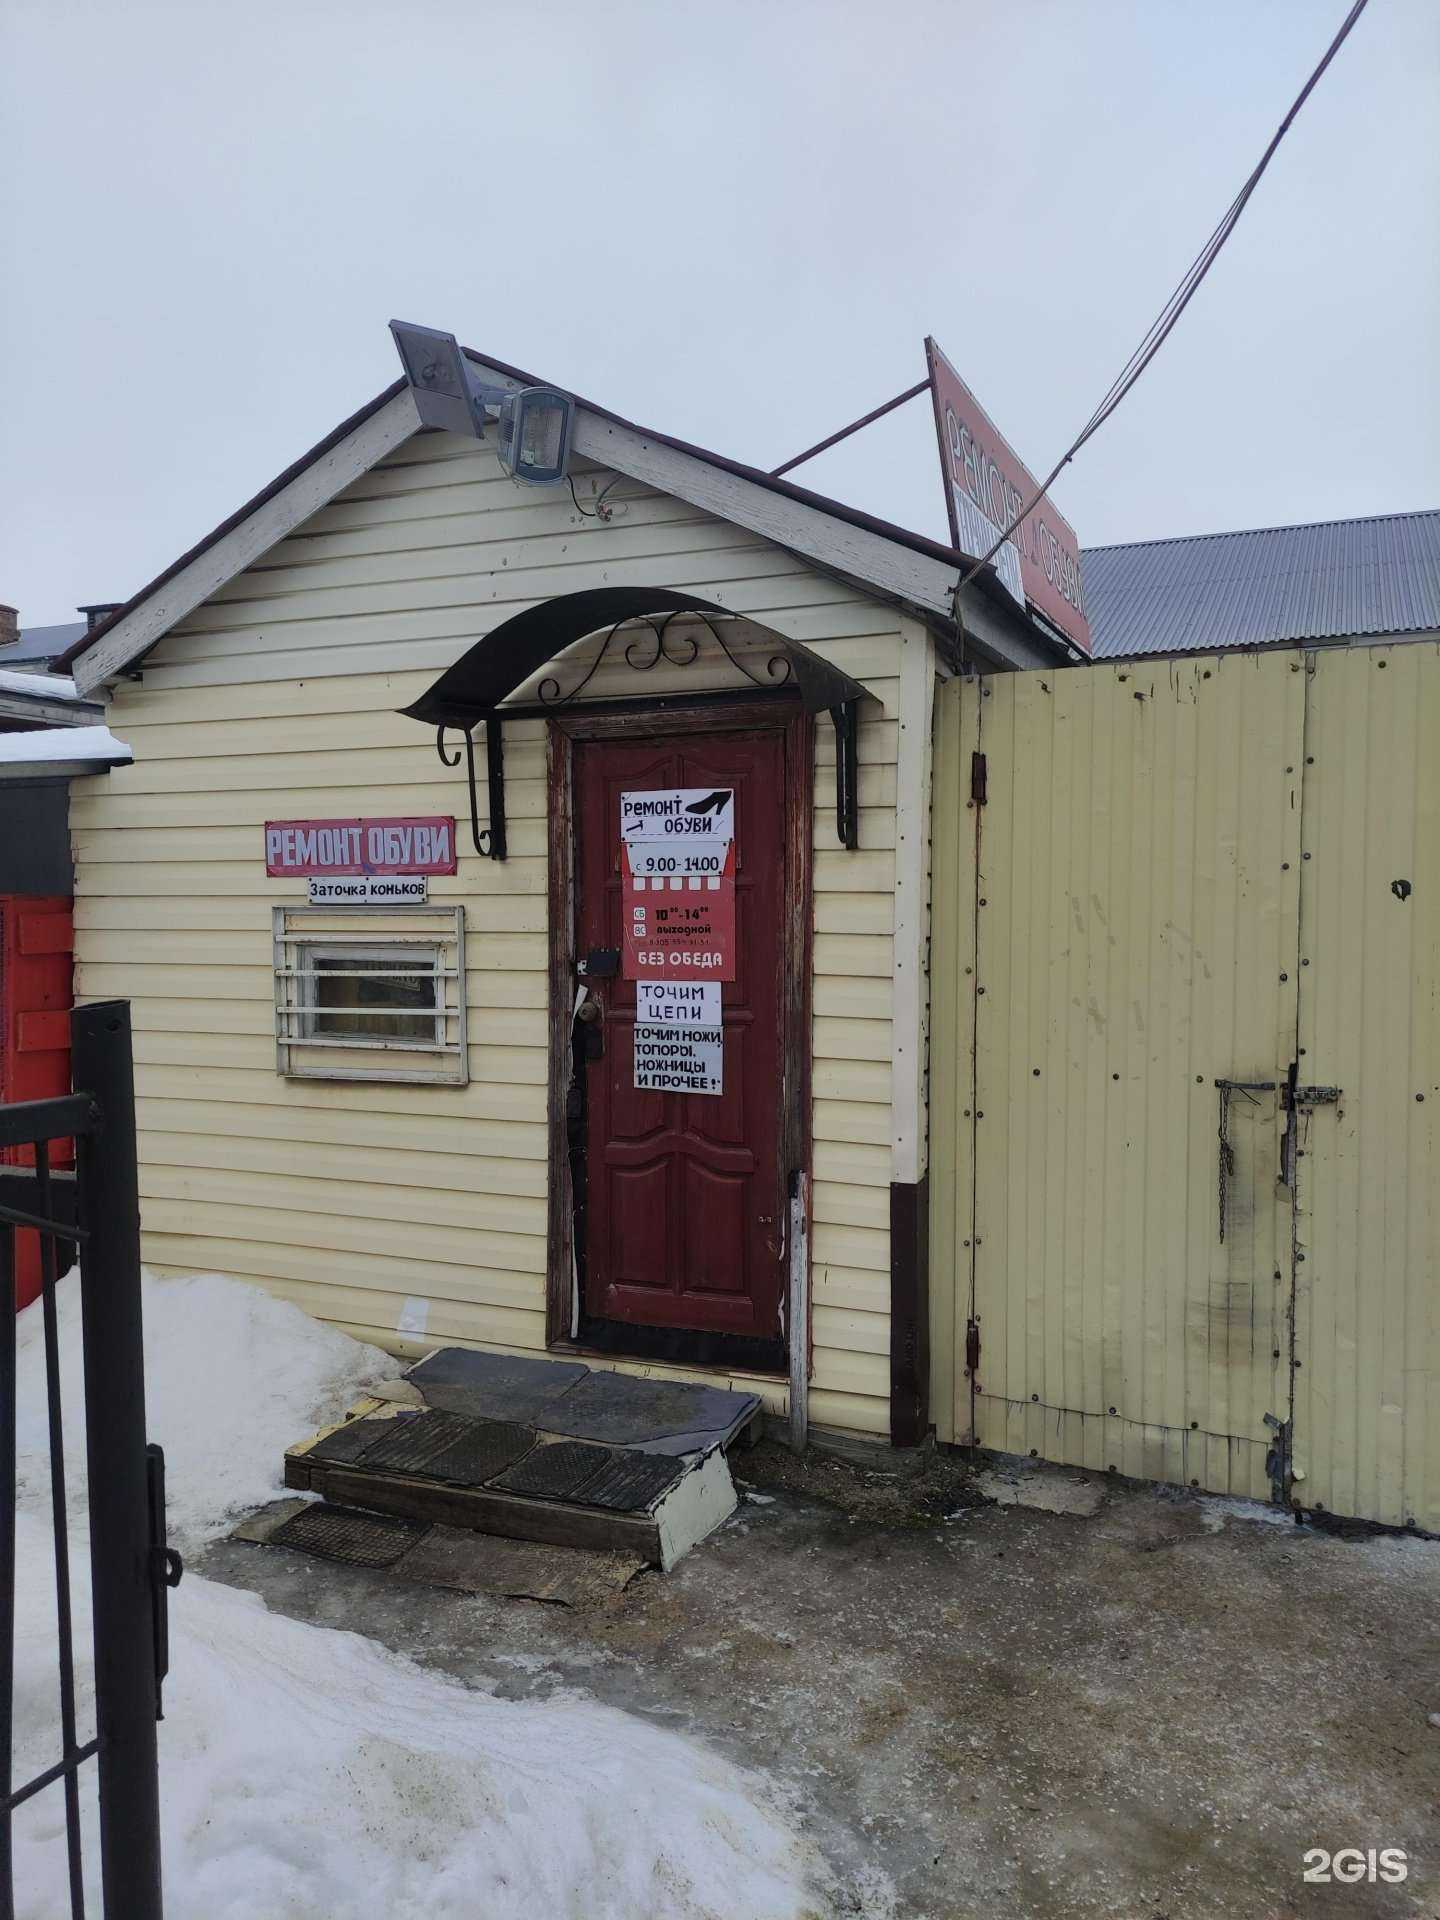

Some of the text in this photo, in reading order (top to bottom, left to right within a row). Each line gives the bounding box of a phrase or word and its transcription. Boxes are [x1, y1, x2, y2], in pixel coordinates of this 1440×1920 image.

[267, 826, 450, 866] РЕМОНТ ОБУВИ
[310, 882, 425, 896] Заточка коньков
[638, 952, 722, 968] БЕЗ ОБЕДА
[641, 985, 705, 1001] ТОЧИМ
[649, 1004, 702, 1020] ЦЕПИ
[634, 1028, 680, 1041] ТОЧИМ
[636, 1059, 706, 1074] НОЖНИЦЫ
[638, 1074, 649, 1086] И
